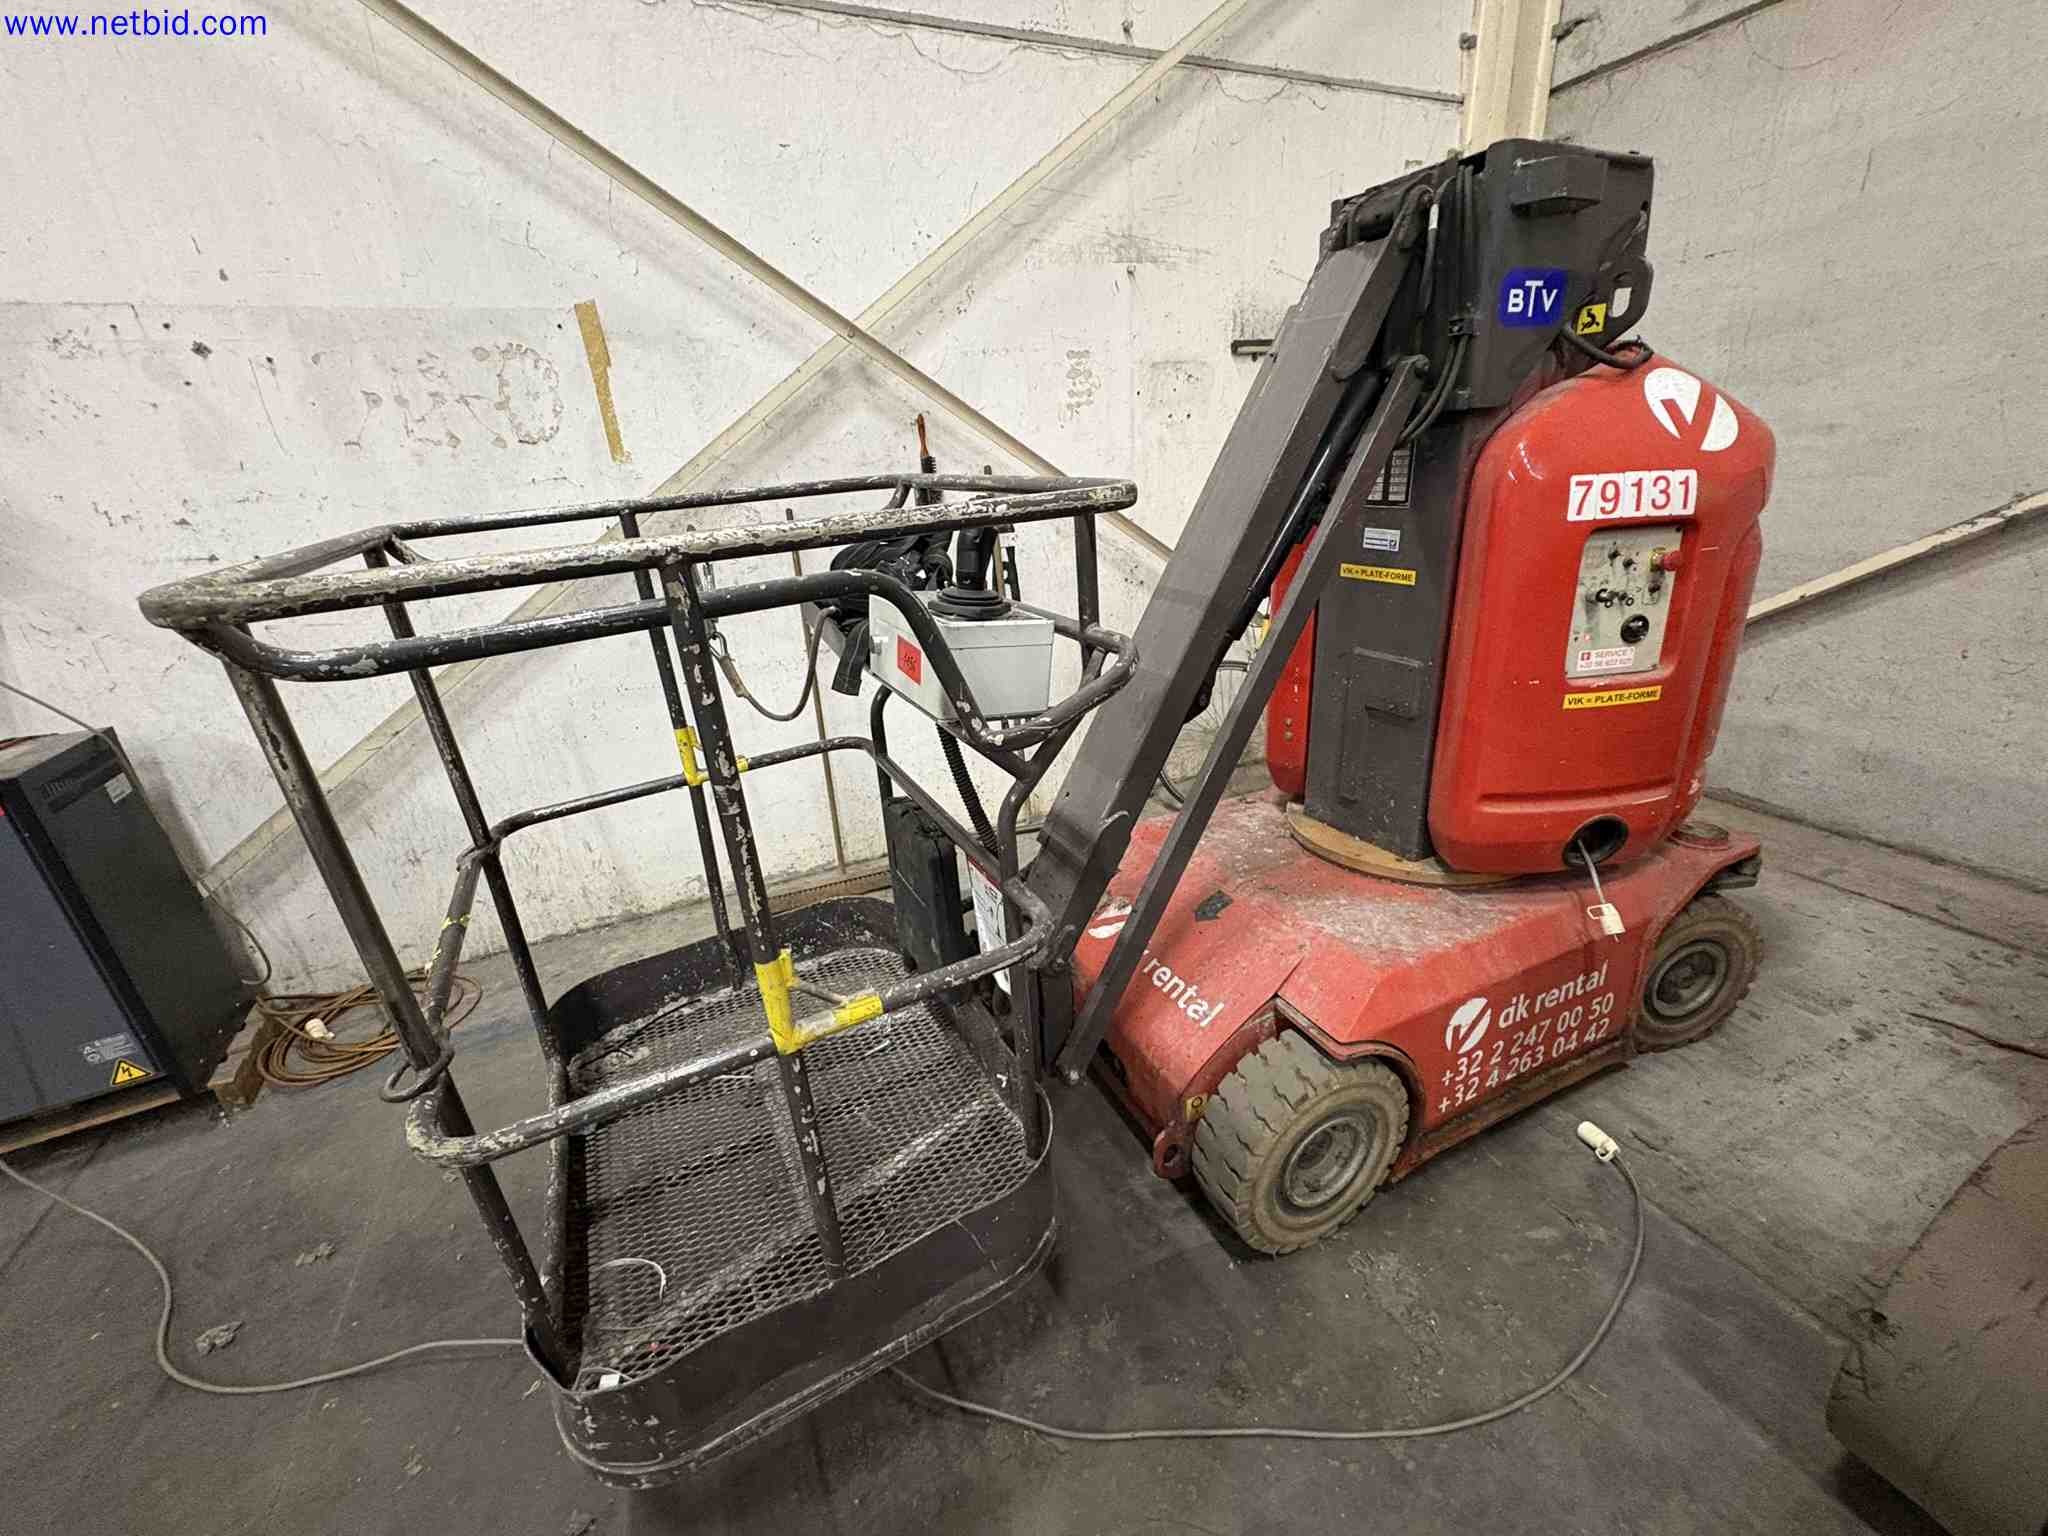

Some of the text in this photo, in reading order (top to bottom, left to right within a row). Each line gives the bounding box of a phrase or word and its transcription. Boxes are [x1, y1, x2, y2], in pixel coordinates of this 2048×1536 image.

[1507, 280, 1558, 317] BTV
[1574, 475, 1690, 516] 79131
[1361, 569, 1414, 582] PLATE-FORME
[1594, 689, 1659, 703] PLATE-FORME
[1143, 958, 1225, 1028] rental
[1534, 959, 1609, 1013] rental
[1442, 992, 1614, 1086] +32 2 247 00 50
[1438, 1018, 1610, 1113] +32 4 263 04 42
